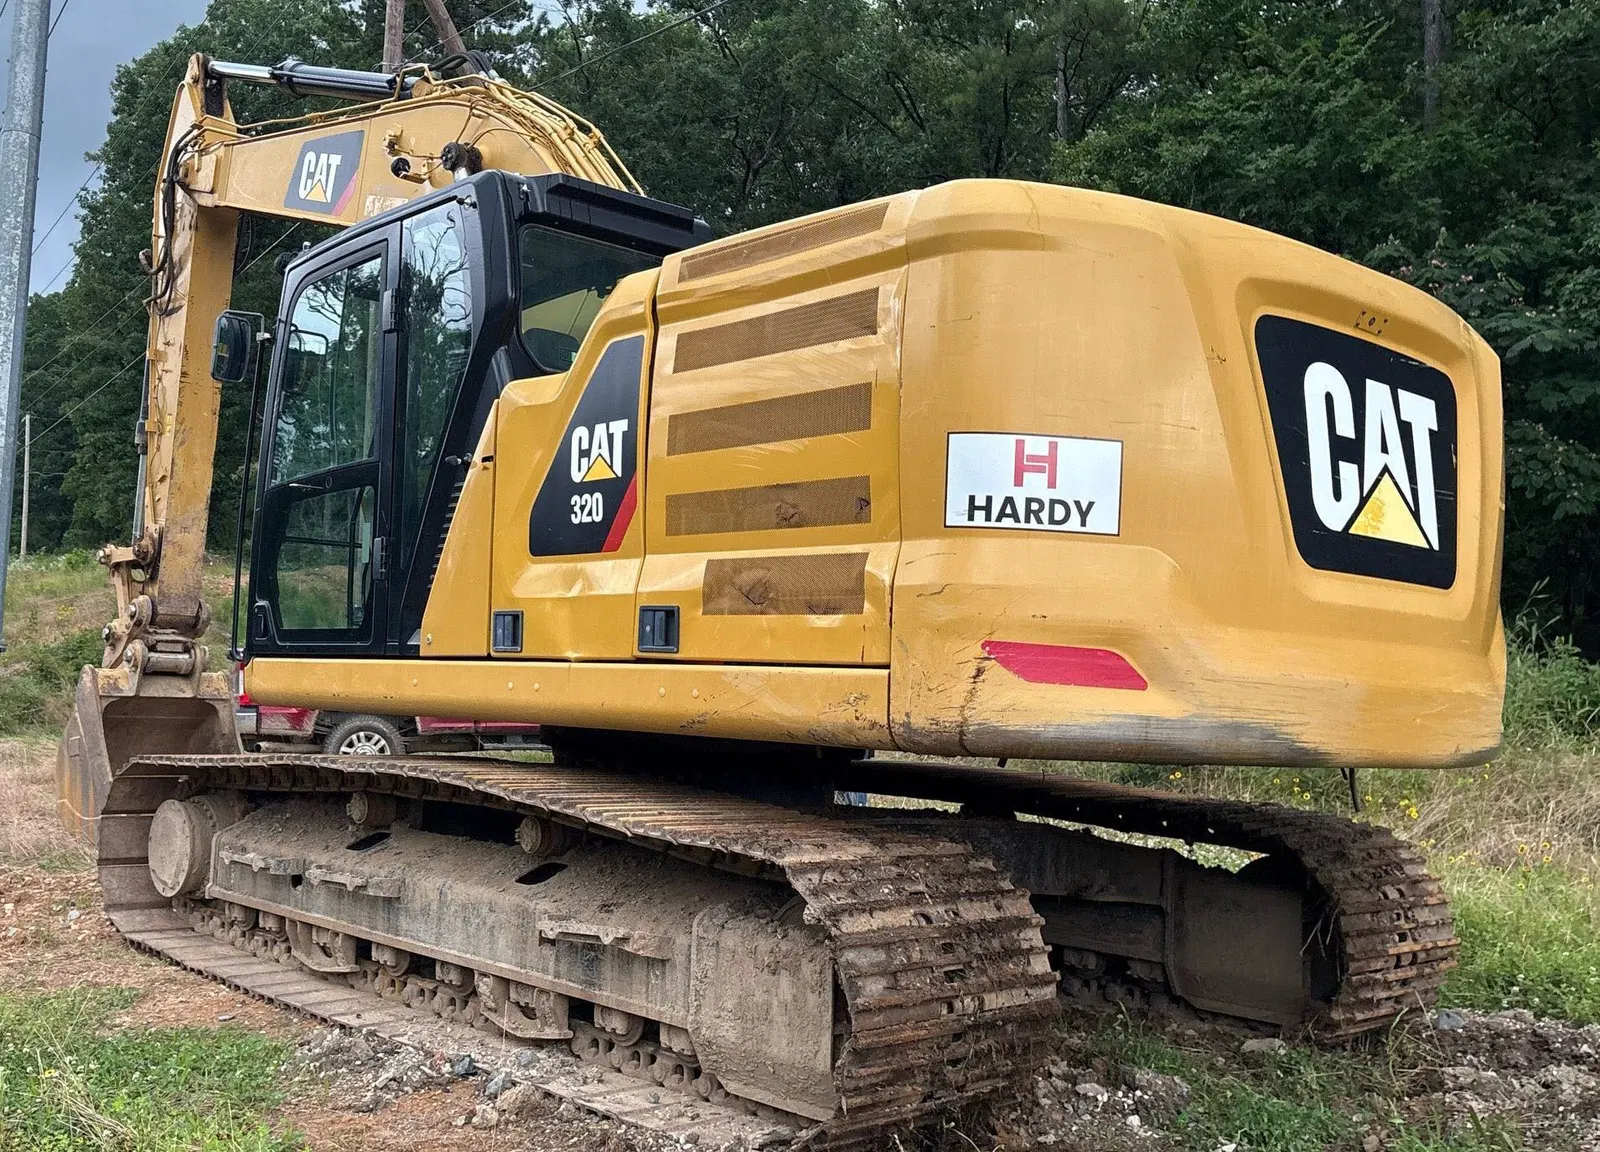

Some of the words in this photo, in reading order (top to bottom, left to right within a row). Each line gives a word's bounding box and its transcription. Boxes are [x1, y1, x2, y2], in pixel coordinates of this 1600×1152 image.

[299, 151, 342, 203] CAT
[571, 419, 628, 483] CAT
[1304, 361, 1439, 551] CAT
[571, 492, 603, 524] 320
[967, 495, 1095, 527] HARDY
